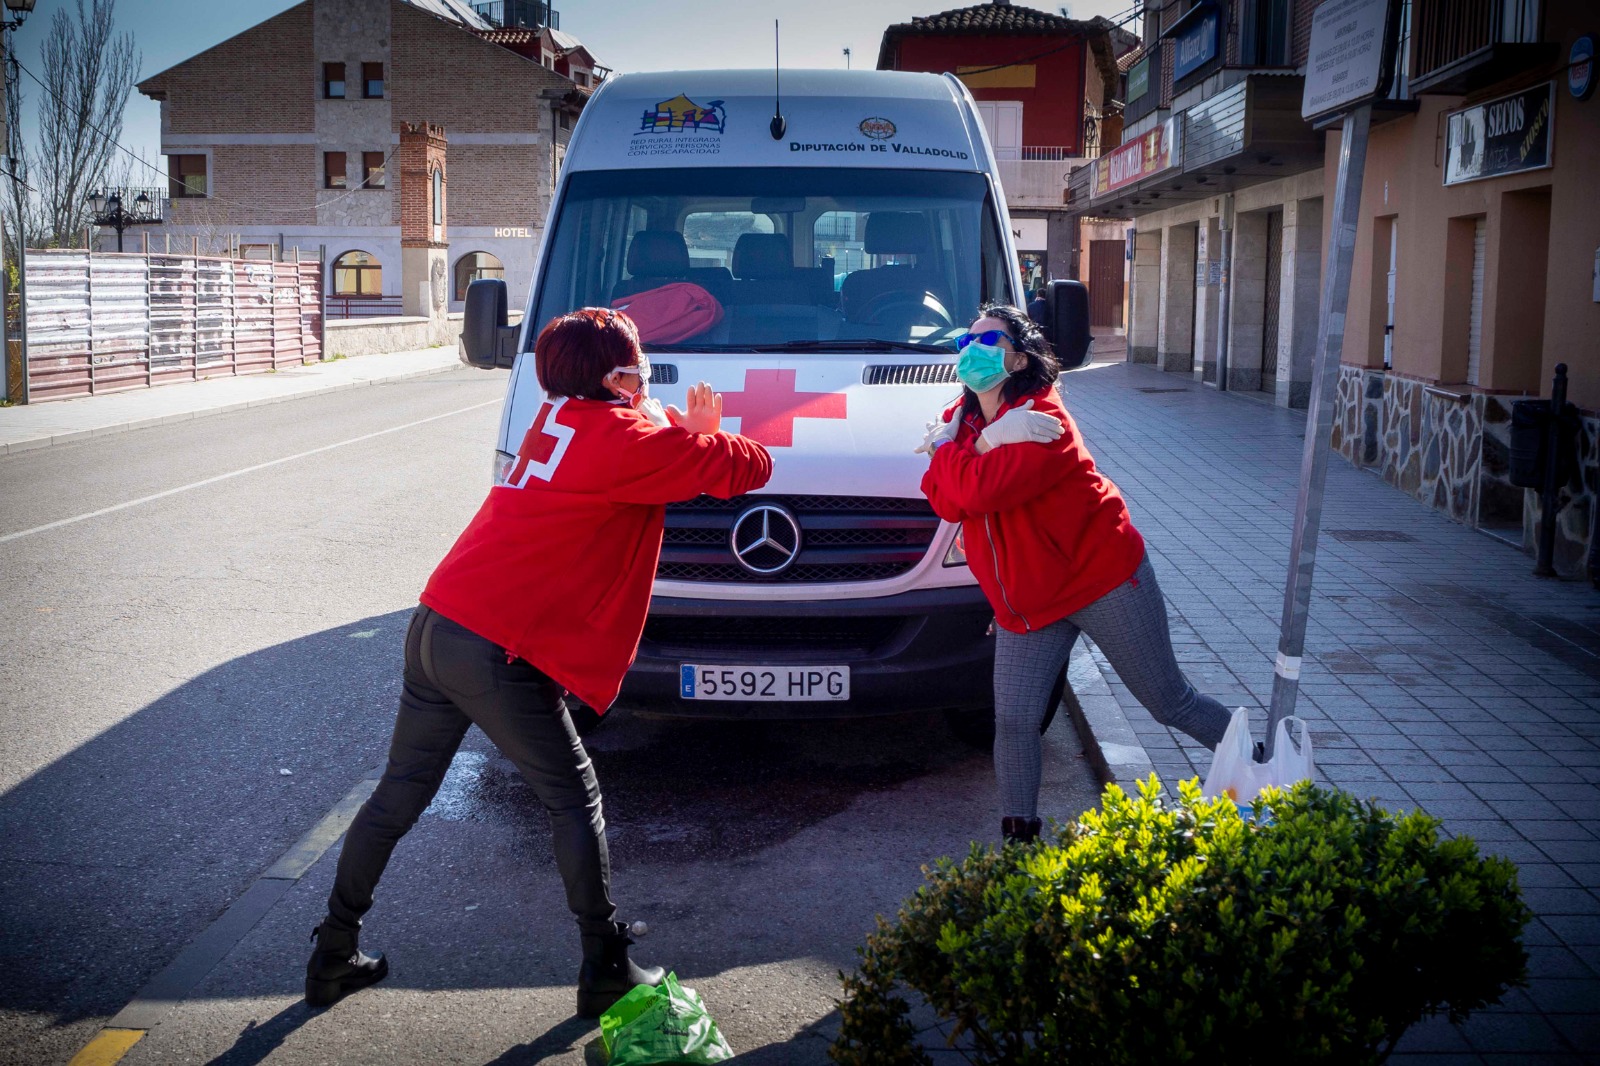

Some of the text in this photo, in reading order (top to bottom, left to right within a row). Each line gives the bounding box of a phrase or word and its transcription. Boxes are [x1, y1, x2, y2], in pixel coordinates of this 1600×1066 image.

[1180, 35, 1201, 67] Allianz
[1487, 96, 1525, 138] SECOS
[1520, 97, 1549, 162] KIOSCO
[629, 143, 673, 151] SERVICIOS
[789, 142, 968, 160] DIPUTACIÓN DE VALLADOLID
[494, 227, 532, 238] HOTEL
[702, 670, 843, 696] 5592 HPG
